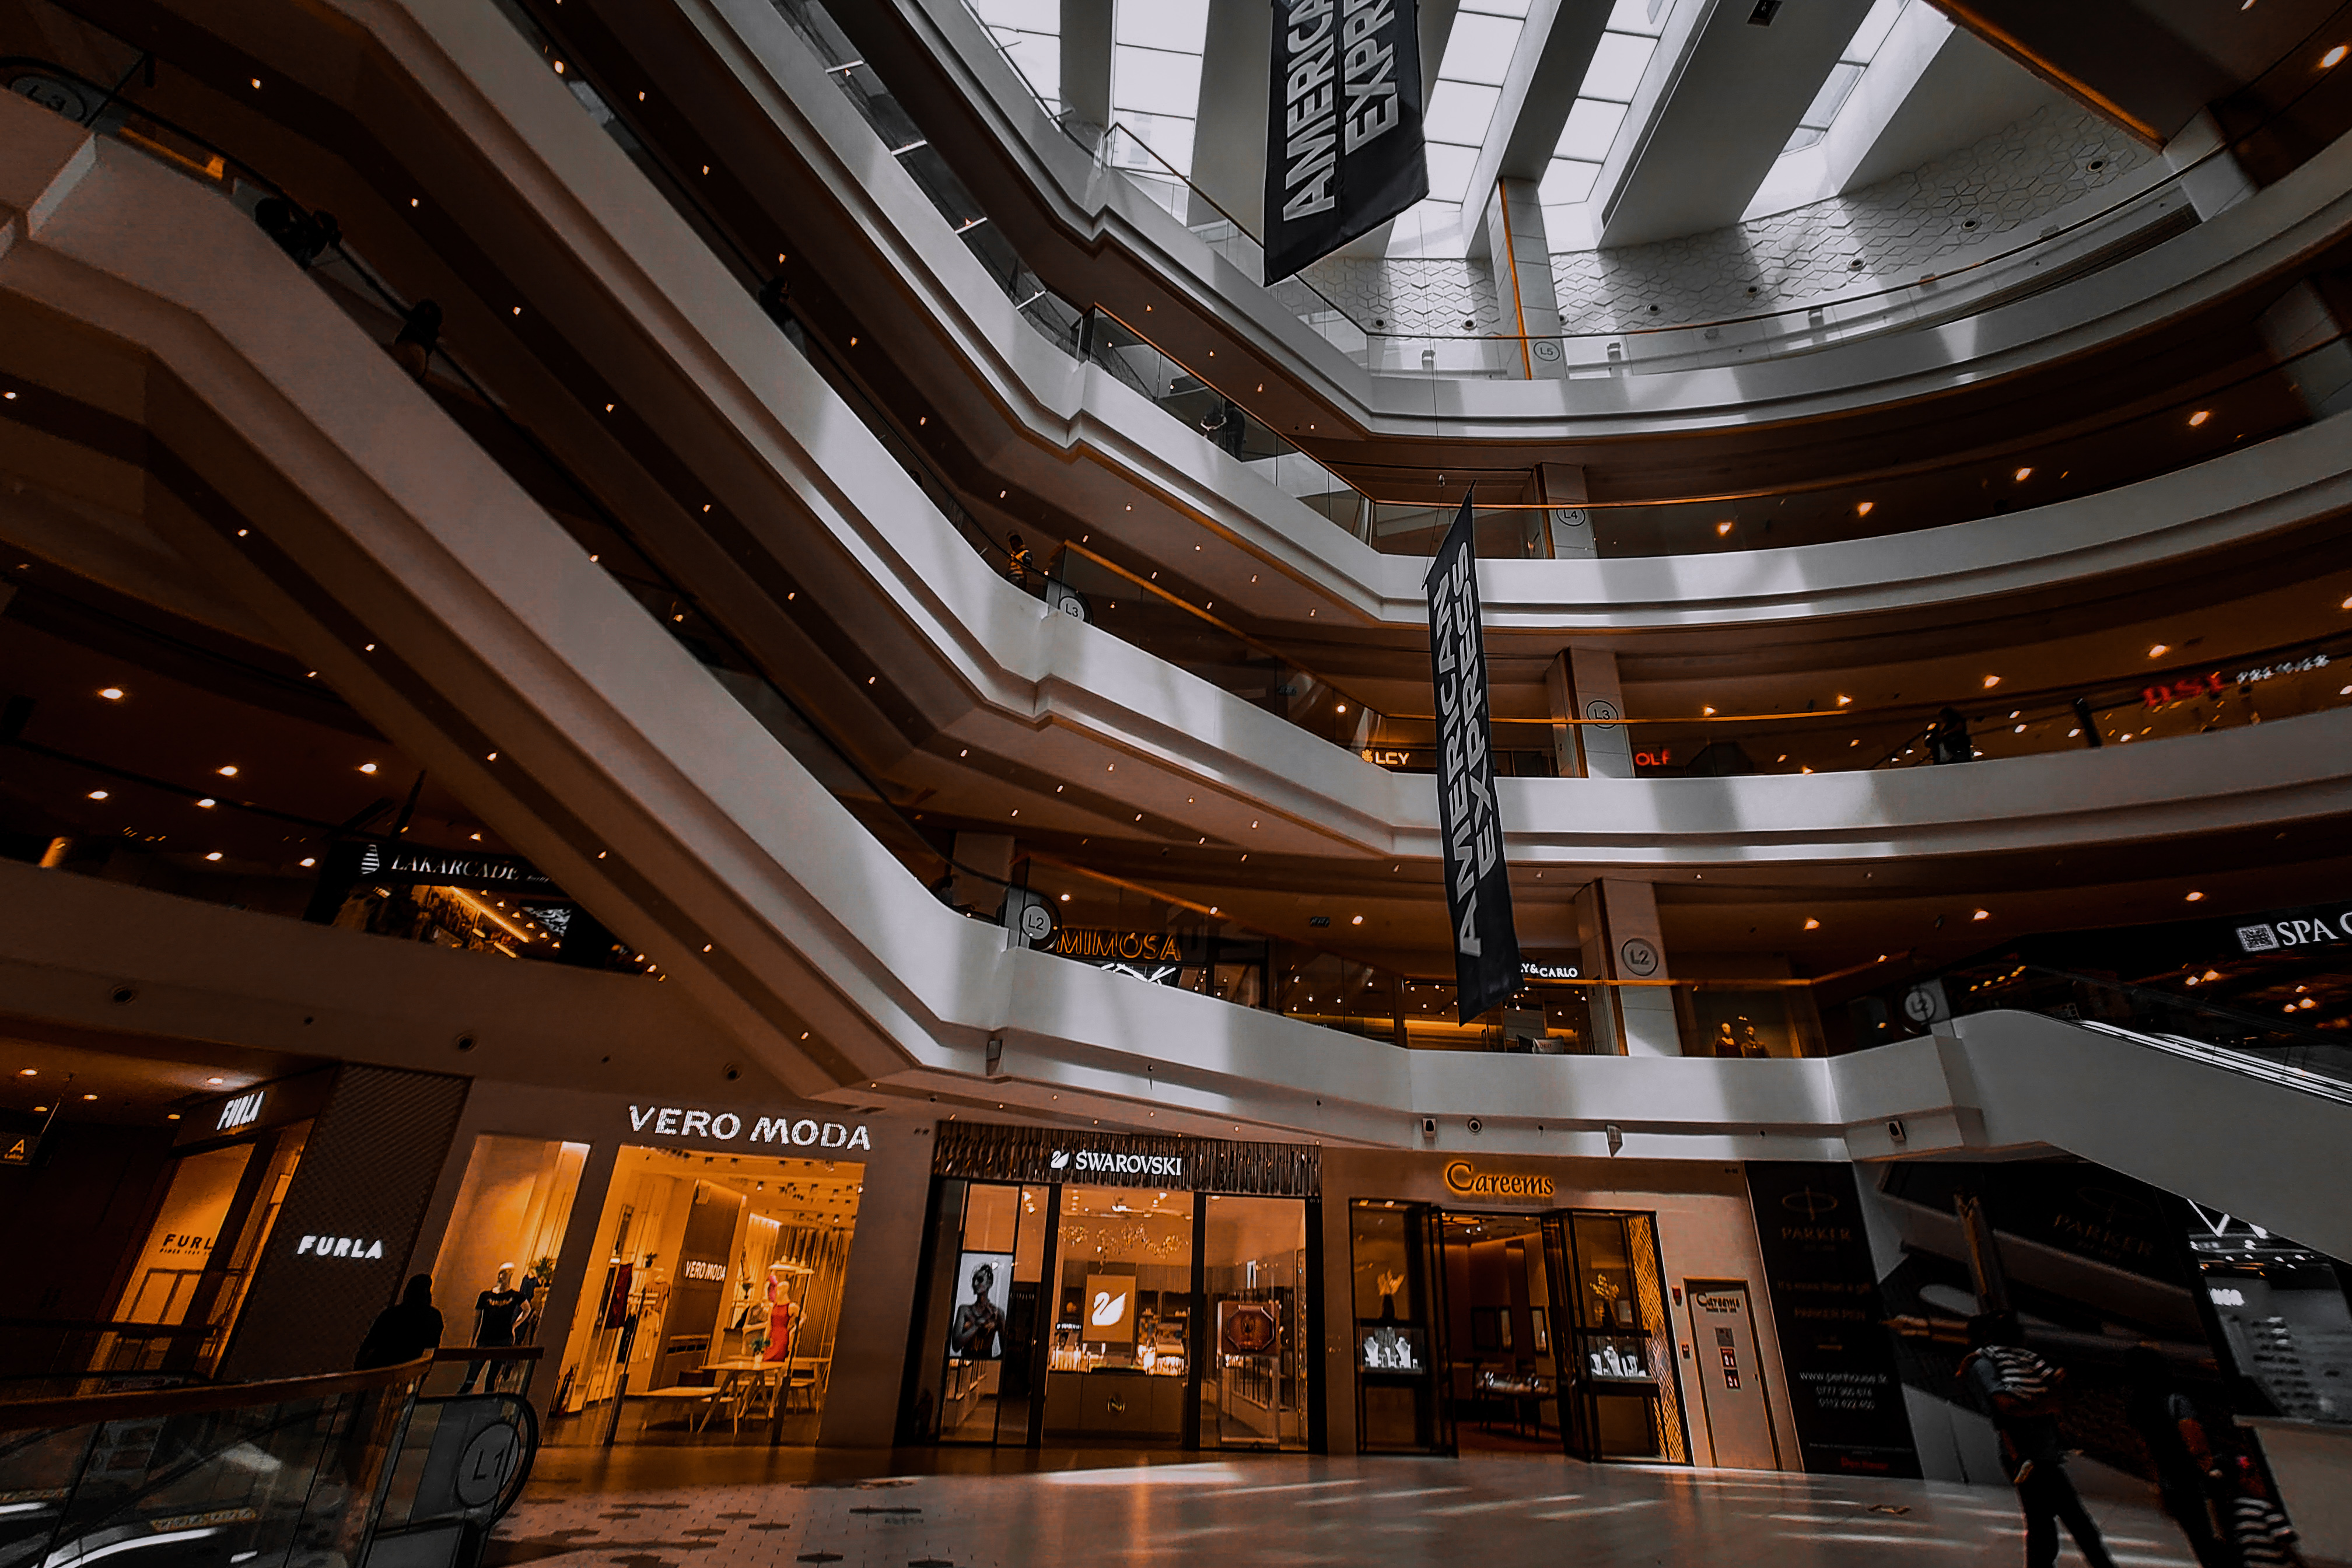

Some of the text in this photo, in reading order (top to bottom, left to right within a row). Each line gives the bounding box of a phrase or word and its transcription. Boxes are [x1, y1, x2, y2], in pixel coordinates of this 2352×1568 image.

[1283, 0, 1336, 222] AMERICA
[1540, 346, 1554, 356] L5
[1563, 509, 1578, 520] L4
[1065, 603, 1079, 617] L3
[1452, 541, 1497, 881] EXPRESS
[1594, 708, 1611, 720] L3
[1375, 751, 1410, 766] LCY
[1433, 571, 1483, 958] AMERICAN
[391, 853, 521, 881] LAKARCADE
[1028, 914, 1044, 931] L2
[2276, 918, 2340, 946] SPA
[1056, 929, 1182, 961] MIMOSA
[1630, 950, 1649, 966] L2
[216, 1090, 265, 1130] FURLA
[629, 1104, 871, 1151] VERO MODA
[9, 1139, 25, 1154] A
[1075, 1149, 1181, 1177] SWAROVSKI
[1446, 1161, 1554, 1195] Careems
[163, 1233, 213, 1250] FURL
[296, 1235, 383, 1259] FURLA
[1781, 1226, 1853, 1242] PARKER
[2053, 1213, 2155, 1259] PARKER
[685, 1260, 726, 1282] VERO MODA
[473, 1448, 506, 1481] L1
